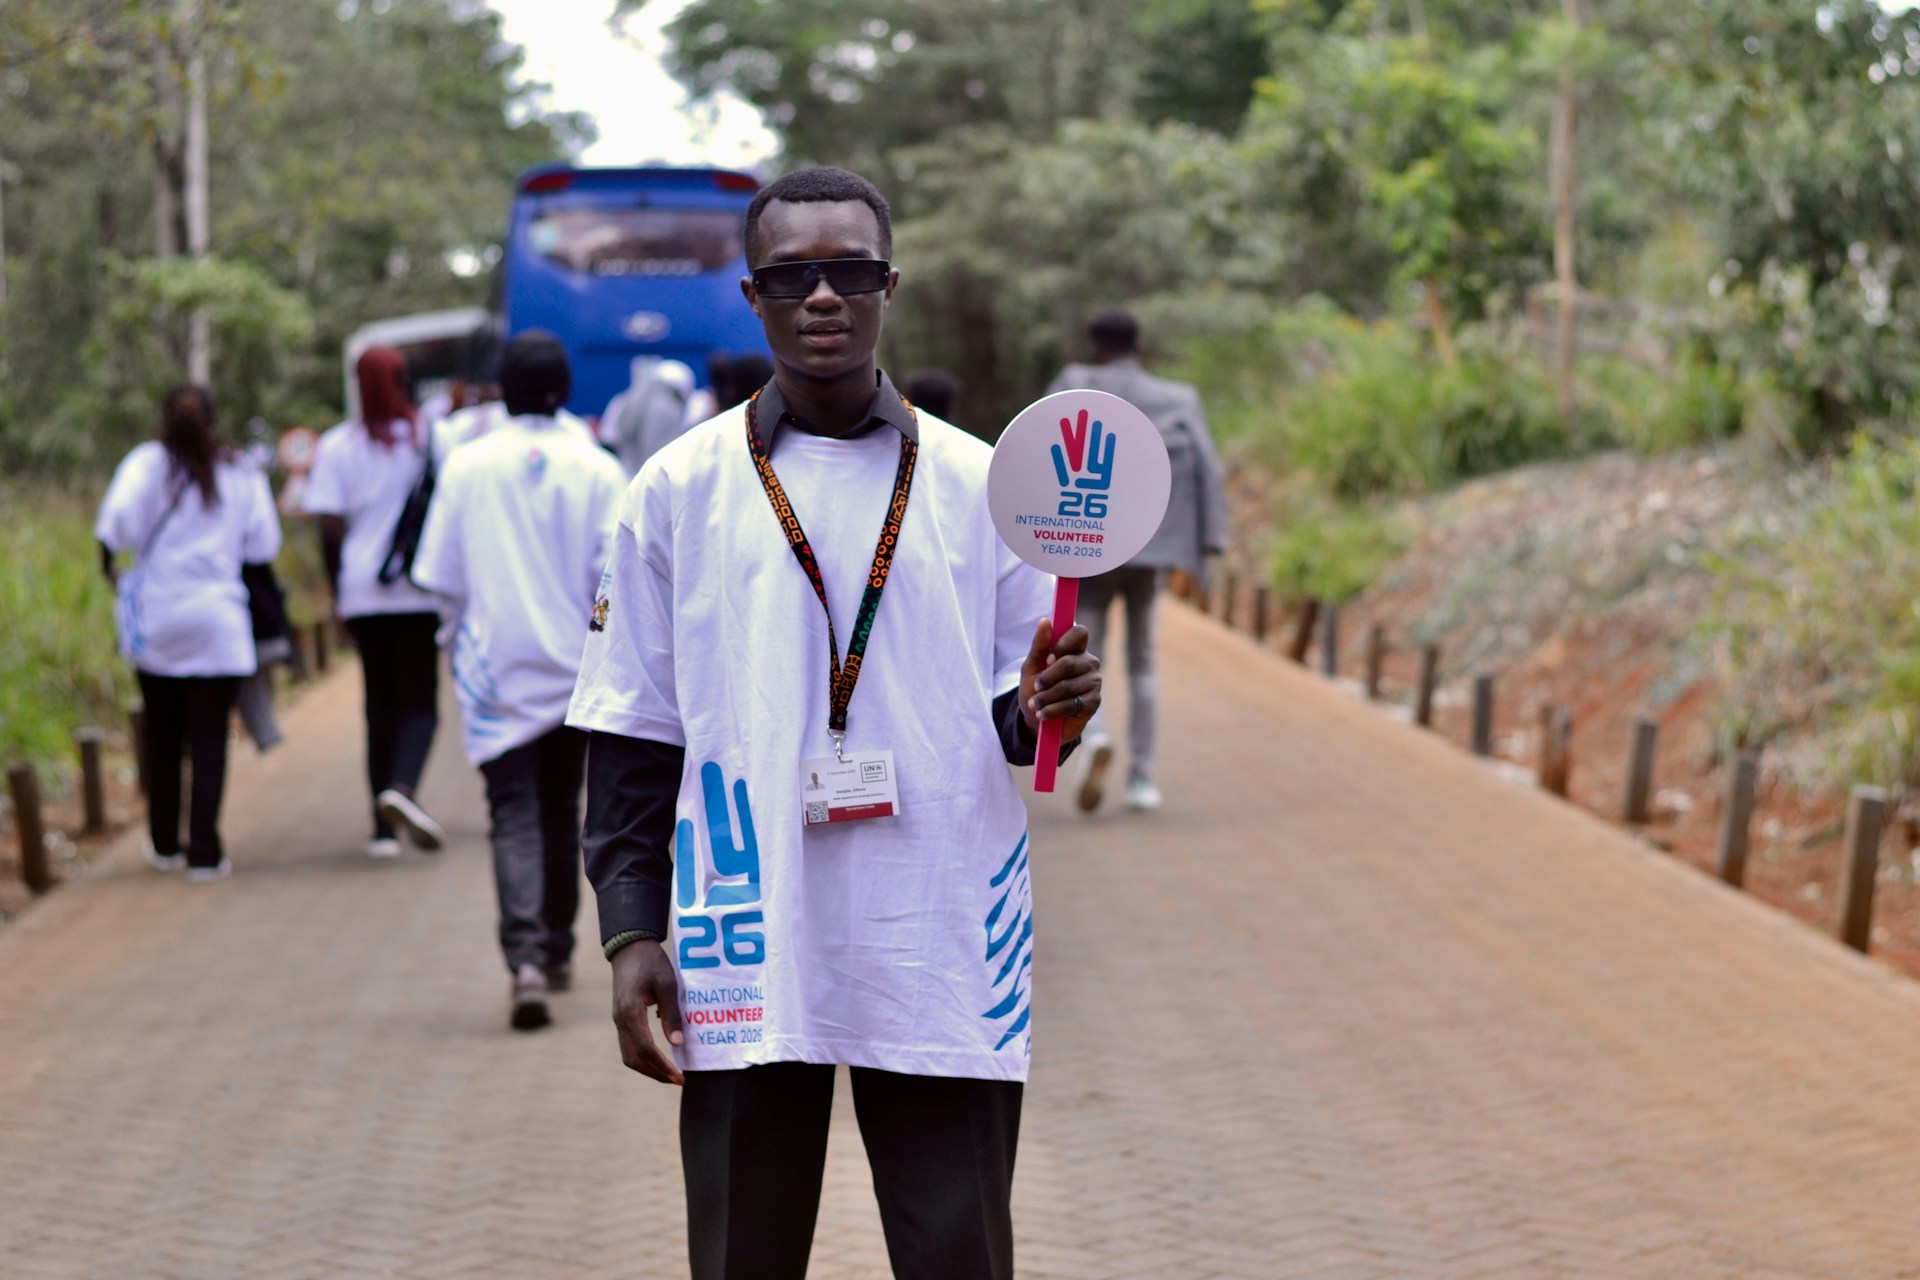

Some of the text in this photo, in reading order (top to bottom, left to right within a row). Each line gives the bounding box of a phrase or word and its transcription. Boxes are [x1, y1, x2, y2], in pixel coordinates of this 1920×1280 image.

[1058, 491, 1109, 518] 26
[1015, 515, 1105, 531] INTERNATIONAL
[1034, 529, 1104, 544] VOLUNTEER
[1041, 544, 1102, 558] YEAR 2026
[678, 911, 765, 970] 26
[682, 986, 764, 1005] RNATIONAL
[685, 1007, 763, 1025] VOLUNTEER
[696, 1028, 763, 1046] YEAR 2026
